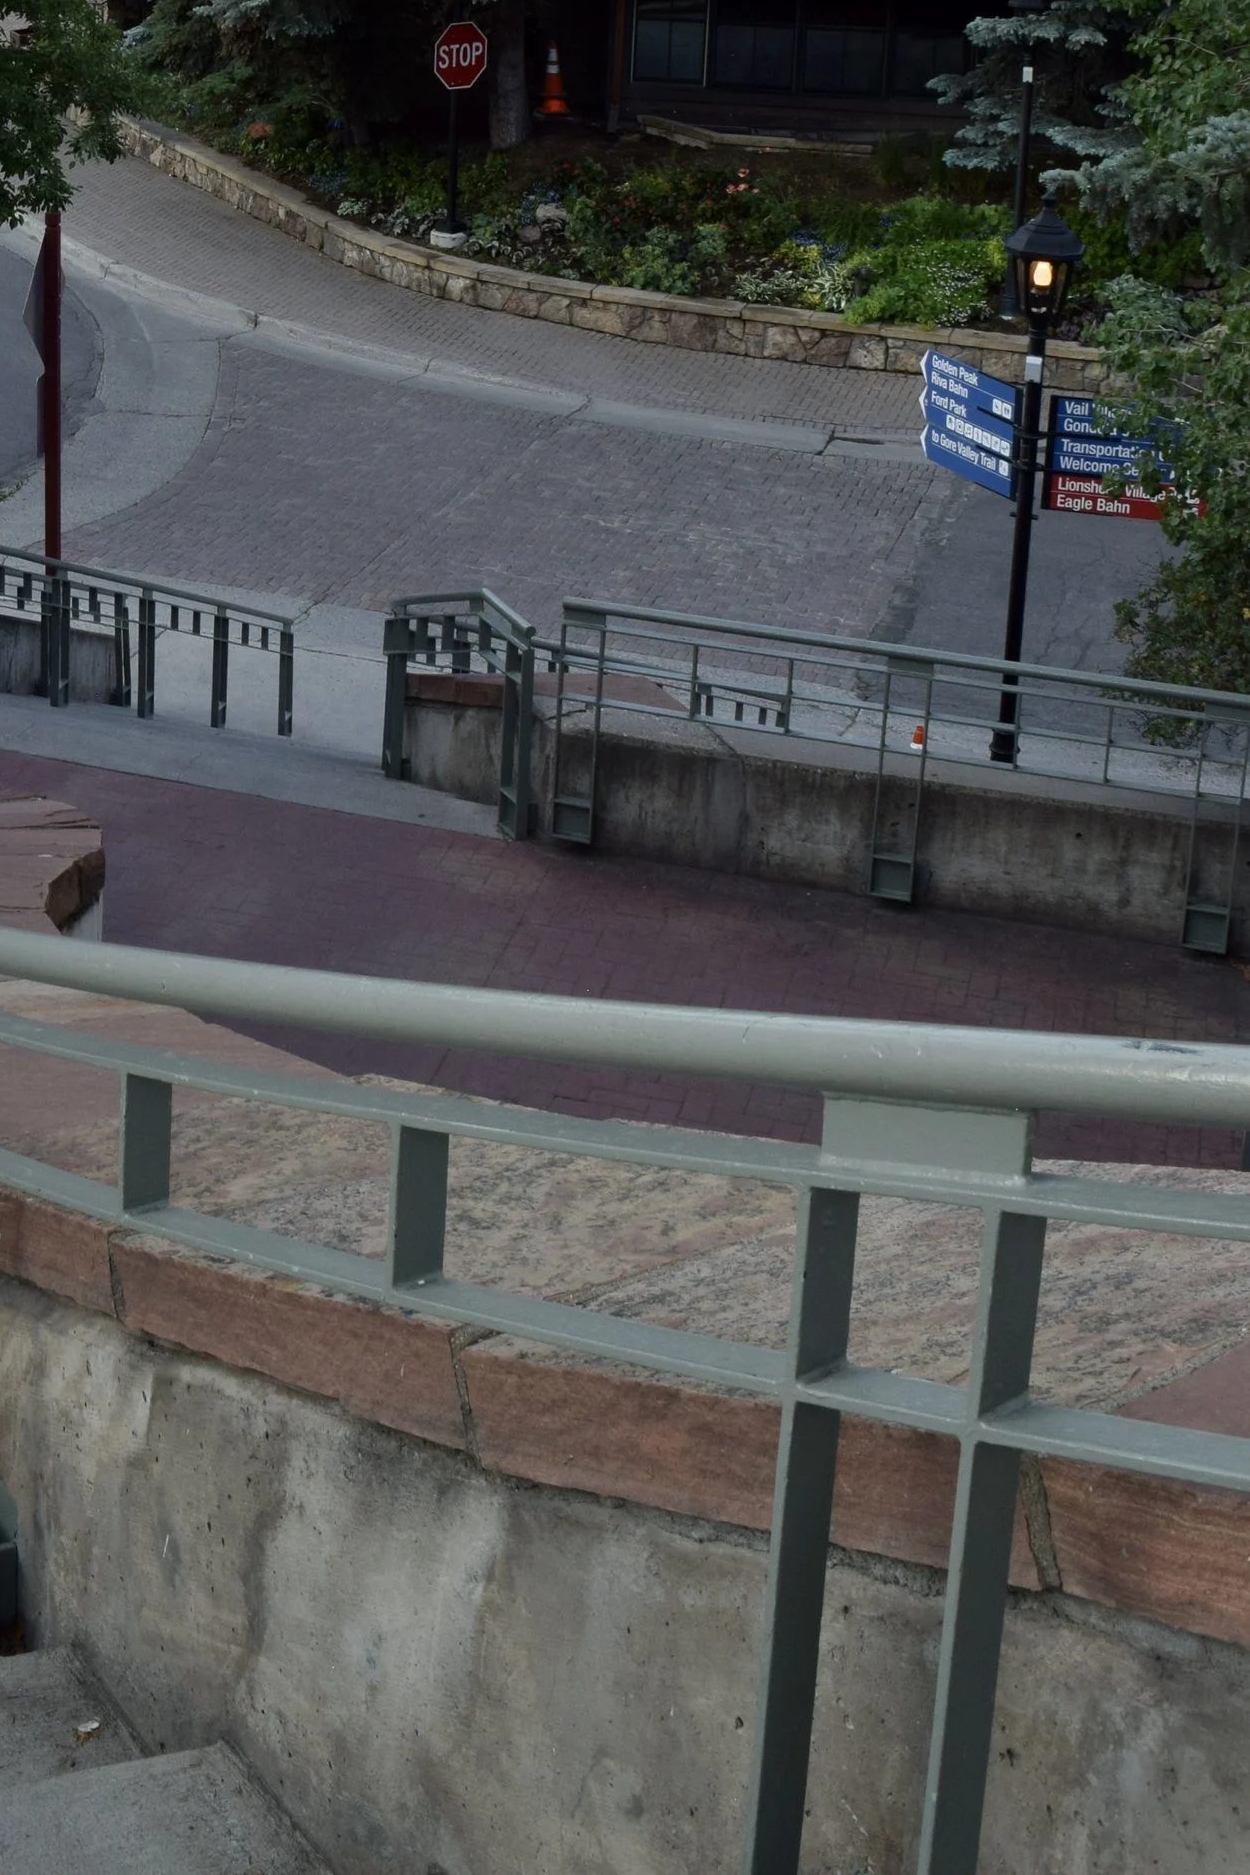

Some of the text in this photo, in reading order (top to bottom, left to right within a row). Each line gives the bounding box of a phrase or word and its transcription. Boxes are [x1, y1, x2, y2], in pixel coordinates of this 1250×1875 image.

[439, 42, 483, 69] STOP
[932, 355, 978, 386] Golden Peak
[931, 371, 968, 399] Riva Bahn
[931, 391, 967, 417] Ford Park
[1065, 401, 1089, 415] Vail
[932, 429, 996, 471] to Gore Valley Trail
[1061, 438, 1154, 458] Transportat
[1059, 455, 1120, 473] Welcome
[1057, 477, 1111, 495] Lionsh
[1056, 494, 1130, 514] Eagle Bahn
